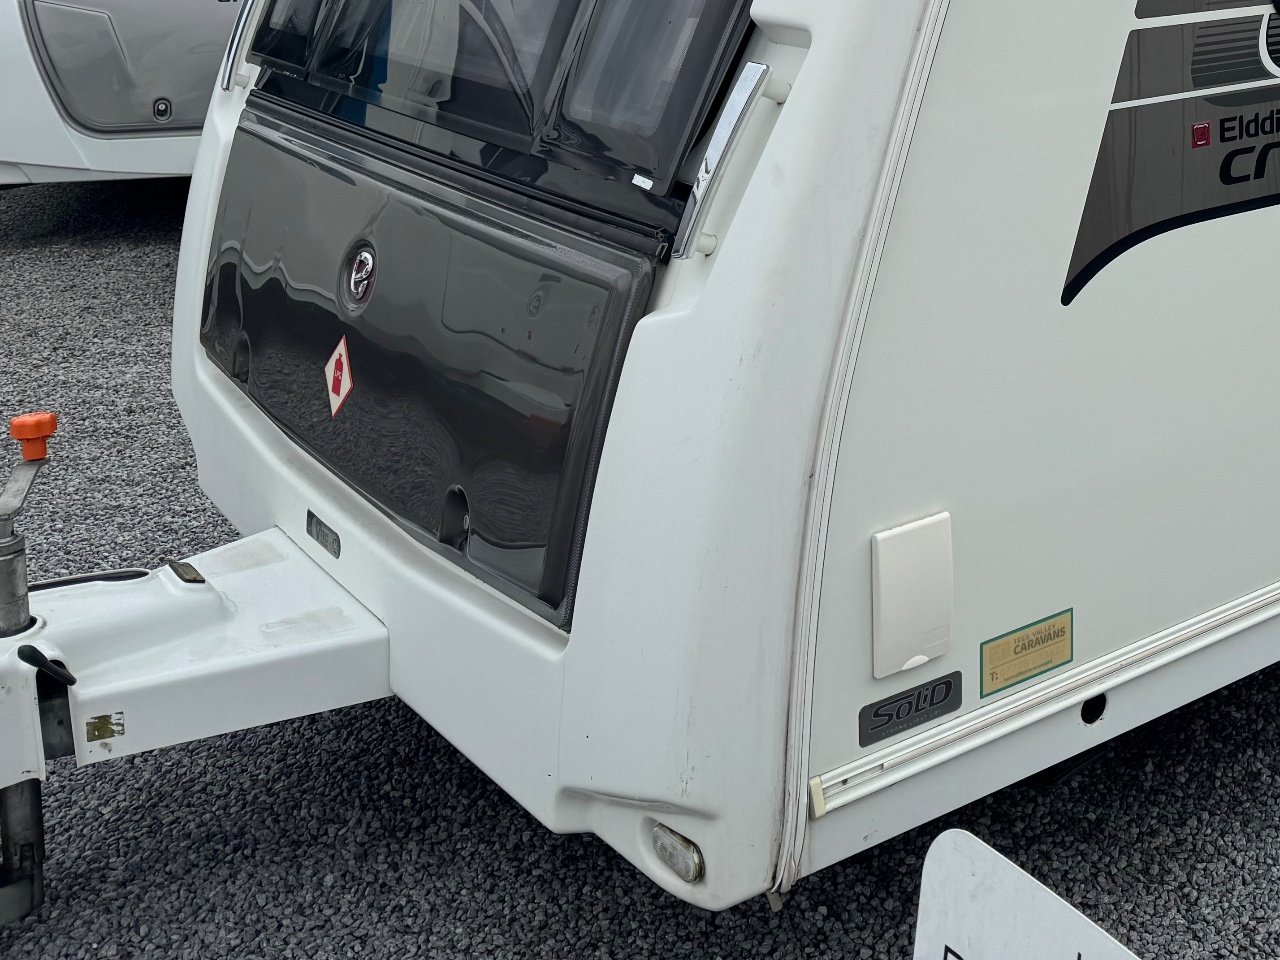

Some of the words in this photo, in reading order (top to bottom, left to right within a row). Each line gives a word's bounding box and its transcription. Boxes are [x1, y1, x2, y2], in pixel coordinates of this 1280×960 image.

[1013, 626, 1067, 656] CARAVANS
[1014, 633, 1030, 645] TEES
[1032, 624, 1057, 638] VALLEY
